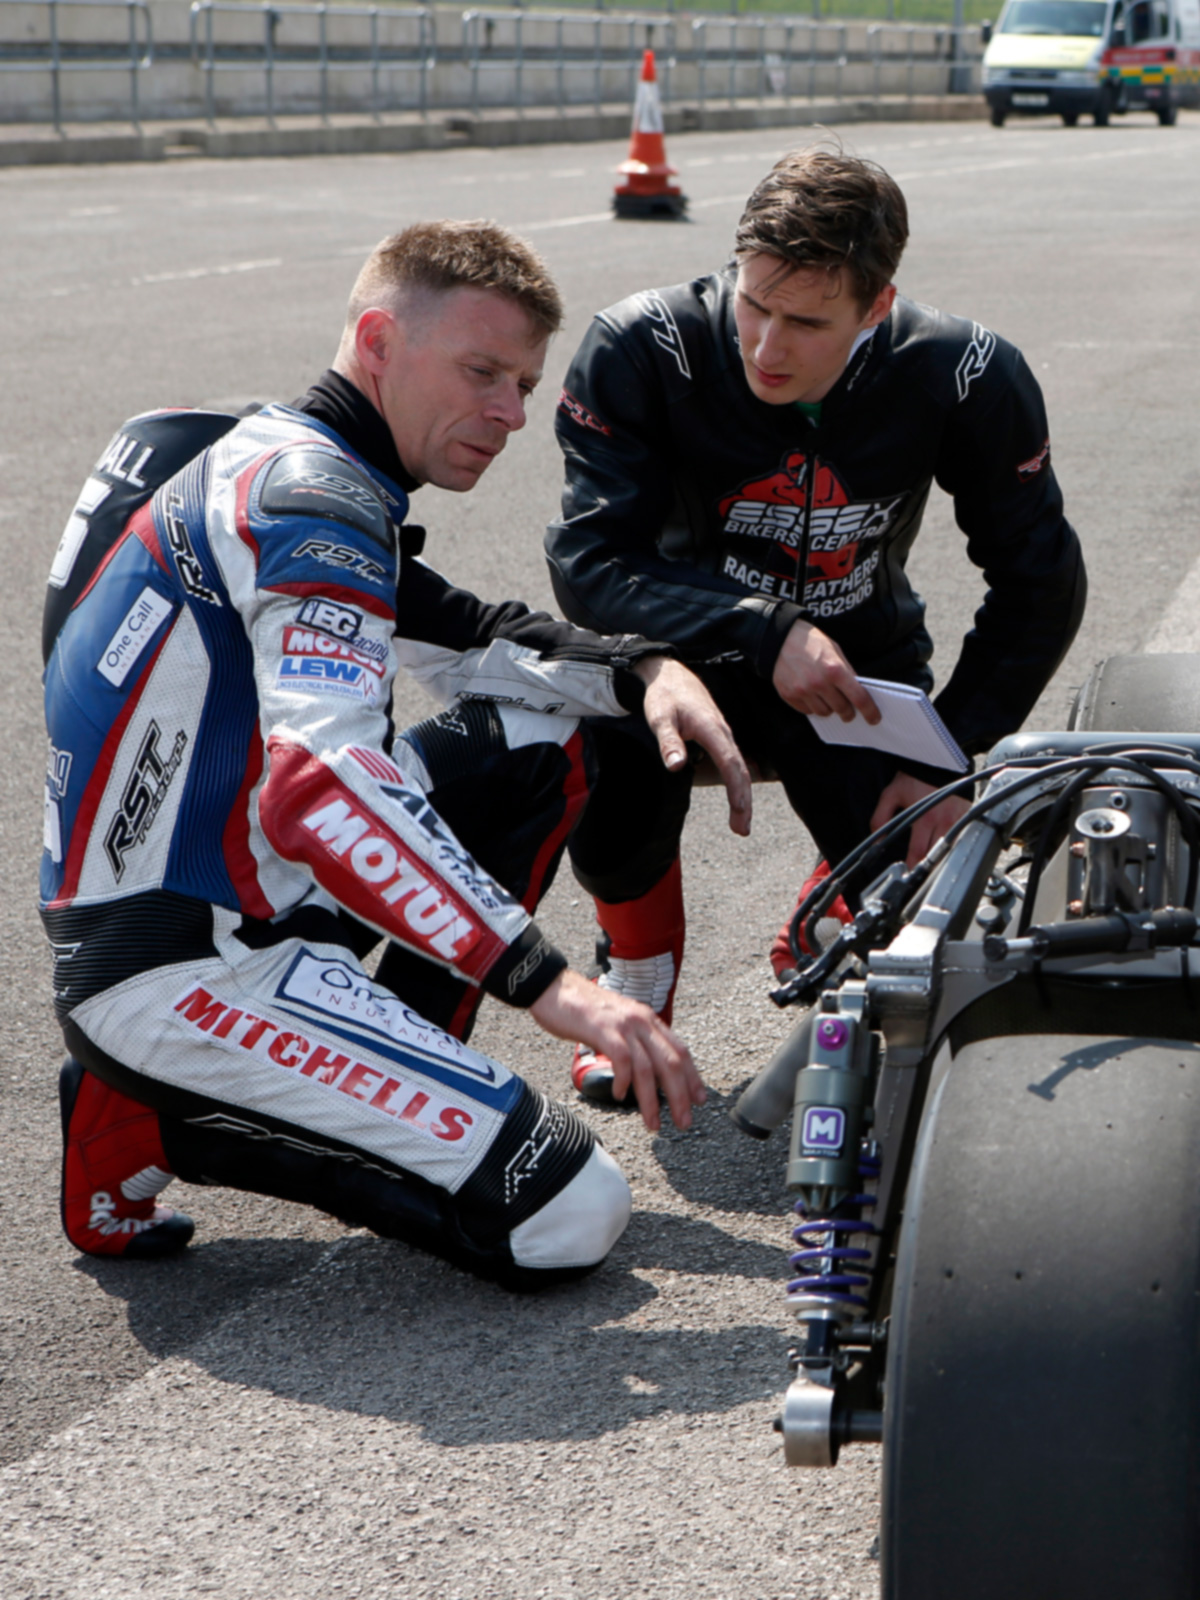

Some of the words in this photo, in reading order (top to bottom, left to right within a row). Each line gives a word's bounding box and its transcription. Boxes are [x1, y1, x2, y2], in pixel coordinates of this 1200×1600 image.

[723, 519, 801, 548] BIKERS
[810, 520, 892, 552] CENTRE
[727, 497, 902, 537] ESSEX
[291, 539, 386, 576] RST
[723, 554, 774, 594] RACE
[778, 549, 881, 601] LEATHERS
[106, 635, 132, 668] One
[127, 600, 154, 633] Call
[116, 612, 162, 676] INSURANCE
[280, 657, 361, 683] LEW
[102, 717, 162, 885] RST
[302, 798, 474, 961] MOTUL
[438, 845, 501, 910] TYRES
[315, 988, 465, 1057] INSURANCE
[173, 987, 474, 1142] MITCHELLS
